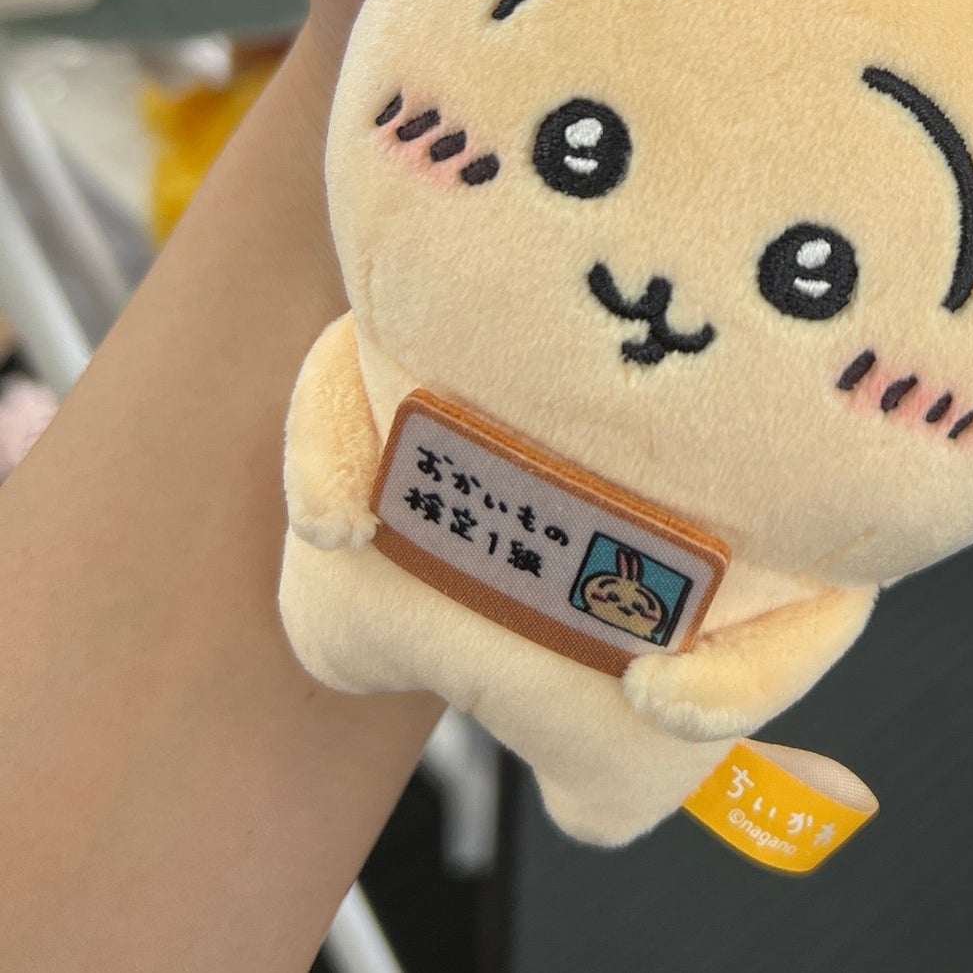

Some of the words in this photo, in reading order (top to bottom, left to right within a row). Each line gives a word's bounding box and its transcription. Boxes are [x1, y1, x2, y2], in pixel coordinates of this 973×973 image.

[403, 486, 542, 578] 検定1級
[416, 446, 570, 547] おかいもの
